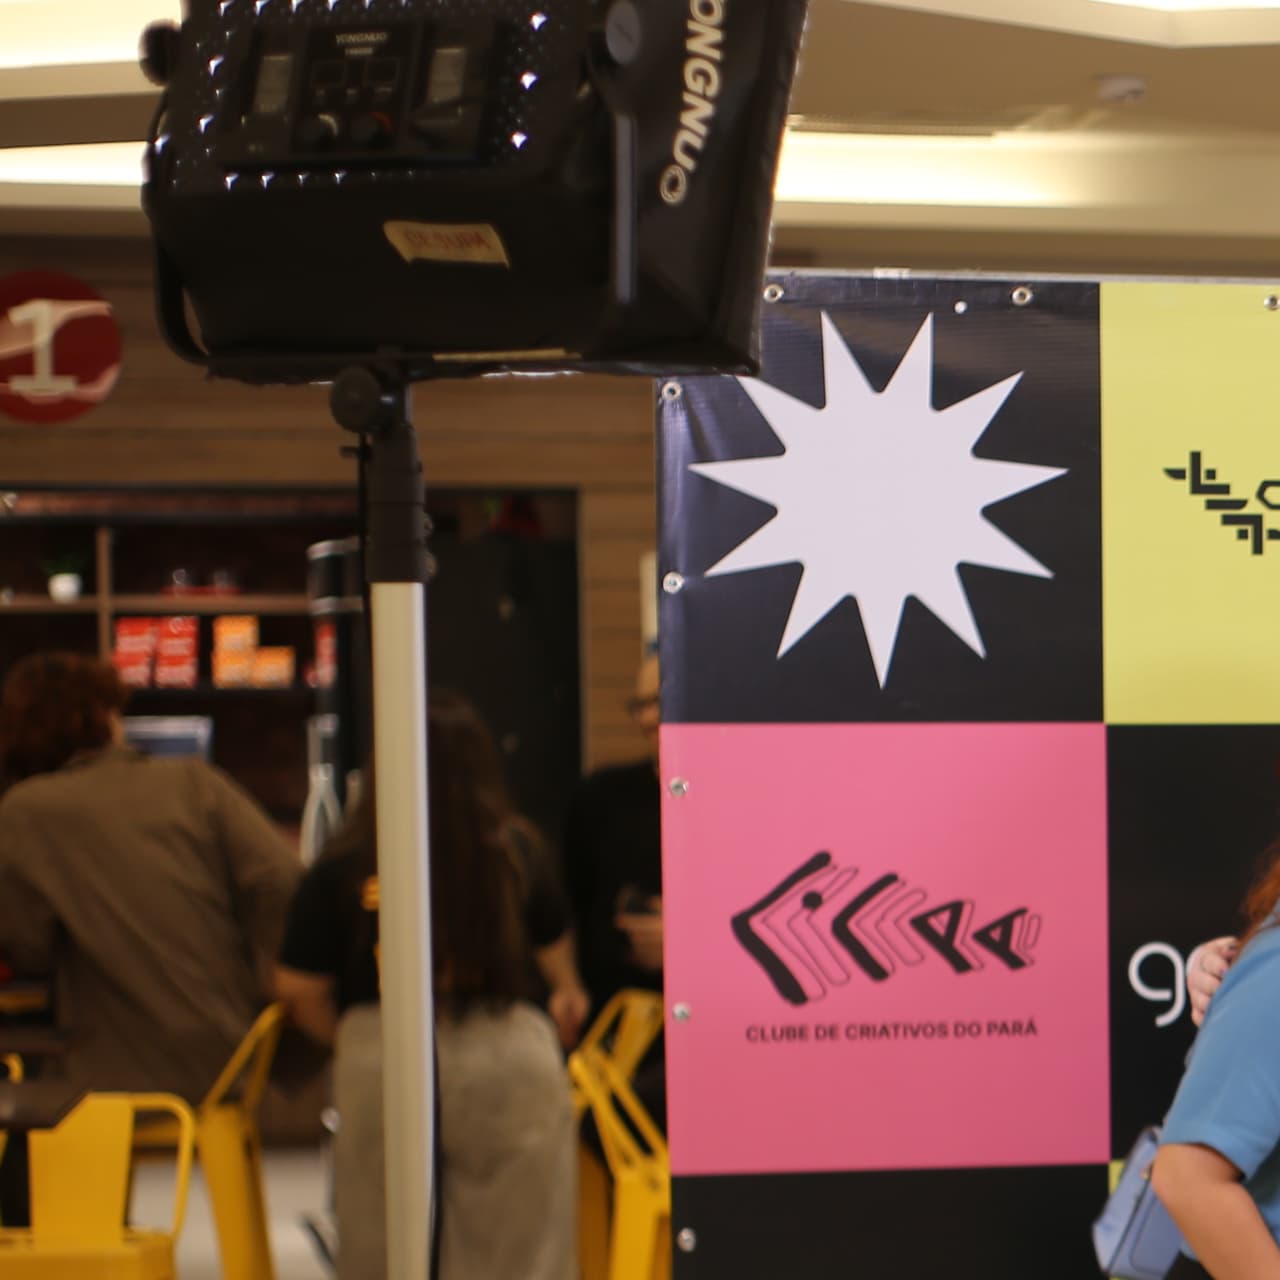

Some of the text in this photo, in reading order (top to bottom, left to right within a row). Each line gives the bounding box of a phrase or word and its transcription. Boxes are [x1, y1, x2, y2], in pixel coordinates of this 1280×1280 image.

[660, 0, 724, 207] ONGNUO
[8, 298, 78, 393] 1
[745, 1017, 1038, 1043] CLUBE DE CRIATIVOS DO PARÁ
